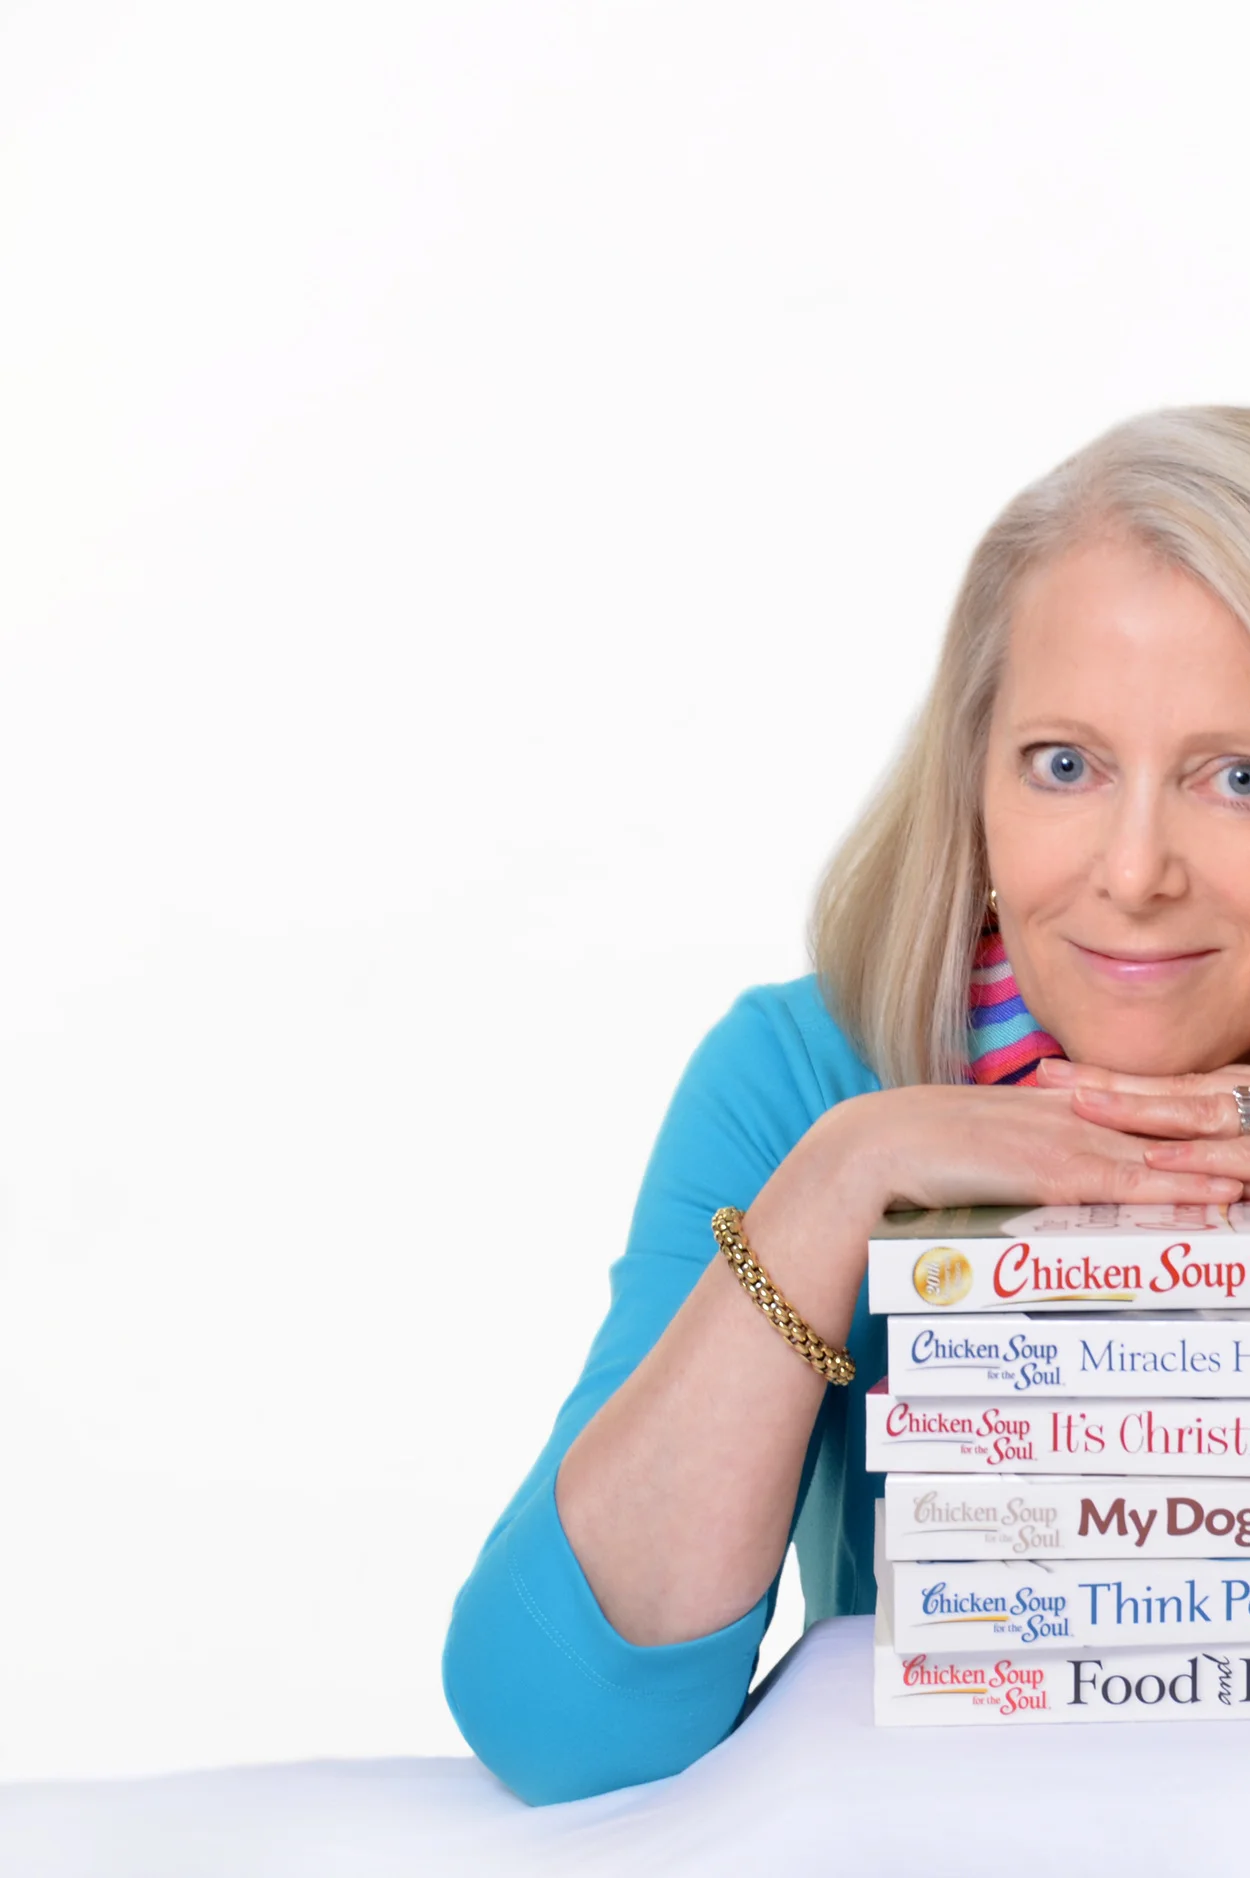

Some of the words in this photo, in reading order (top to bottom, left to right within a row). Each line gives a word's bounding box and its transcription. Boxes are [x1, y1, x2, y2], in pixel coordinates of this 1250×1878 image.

[993, 1243, 1143, 1298] Chicken
[1149, 1243, 1246, 1297] Soup
[911, 1330, 1000, 1364] Chicken
[1002, 1334, 1058, 1365] Soup
[1080, 1339, 1221, 1374] Miracles
[987, 1370, 1000, 1380] for
[1001, 1370, 1016, 1380] the
[1014, 1362, 1061, 1391] Soul
[886, 1402, 973, 1437] Chicken
[976, 1408, 1031, 1440] Soup
[1050, 1412, 1106, 1454] It's
[960, 1444, 972, 1454] for
[974, 1444, 988, 1454] the
[986, 1436, 1034, 1465] Soul
[913, 1490, 998, 1523] Chicken
[1000, 1497, 1058, 1528] Soup
[1077, 1497, 1158, 1547] My
[1012, 1524, 1060, 1553] Soul
[921, 1582, 1007, 1615] Chicken
[1009, 1587, 1066, 1617] Soup
[1078, 1580, 1212, 1624] Think
[993, 1624, 1006, 1633] for
[1007, 1623, 1023, 1633] the
[1021, 1614, 1069, 1643] Soul
[902, 1654, 985, 1687] Chicken
[988, 1659, 1044, 1690] Soup
[1066, 1656, 1202, 1707] Food
[1202, 1653, 1232, 1706] and
[972, 1695, 984, 1705] for
[986, 1695, 1001, 1705] the
[1000, 1687, 1047, 1716] Soul
